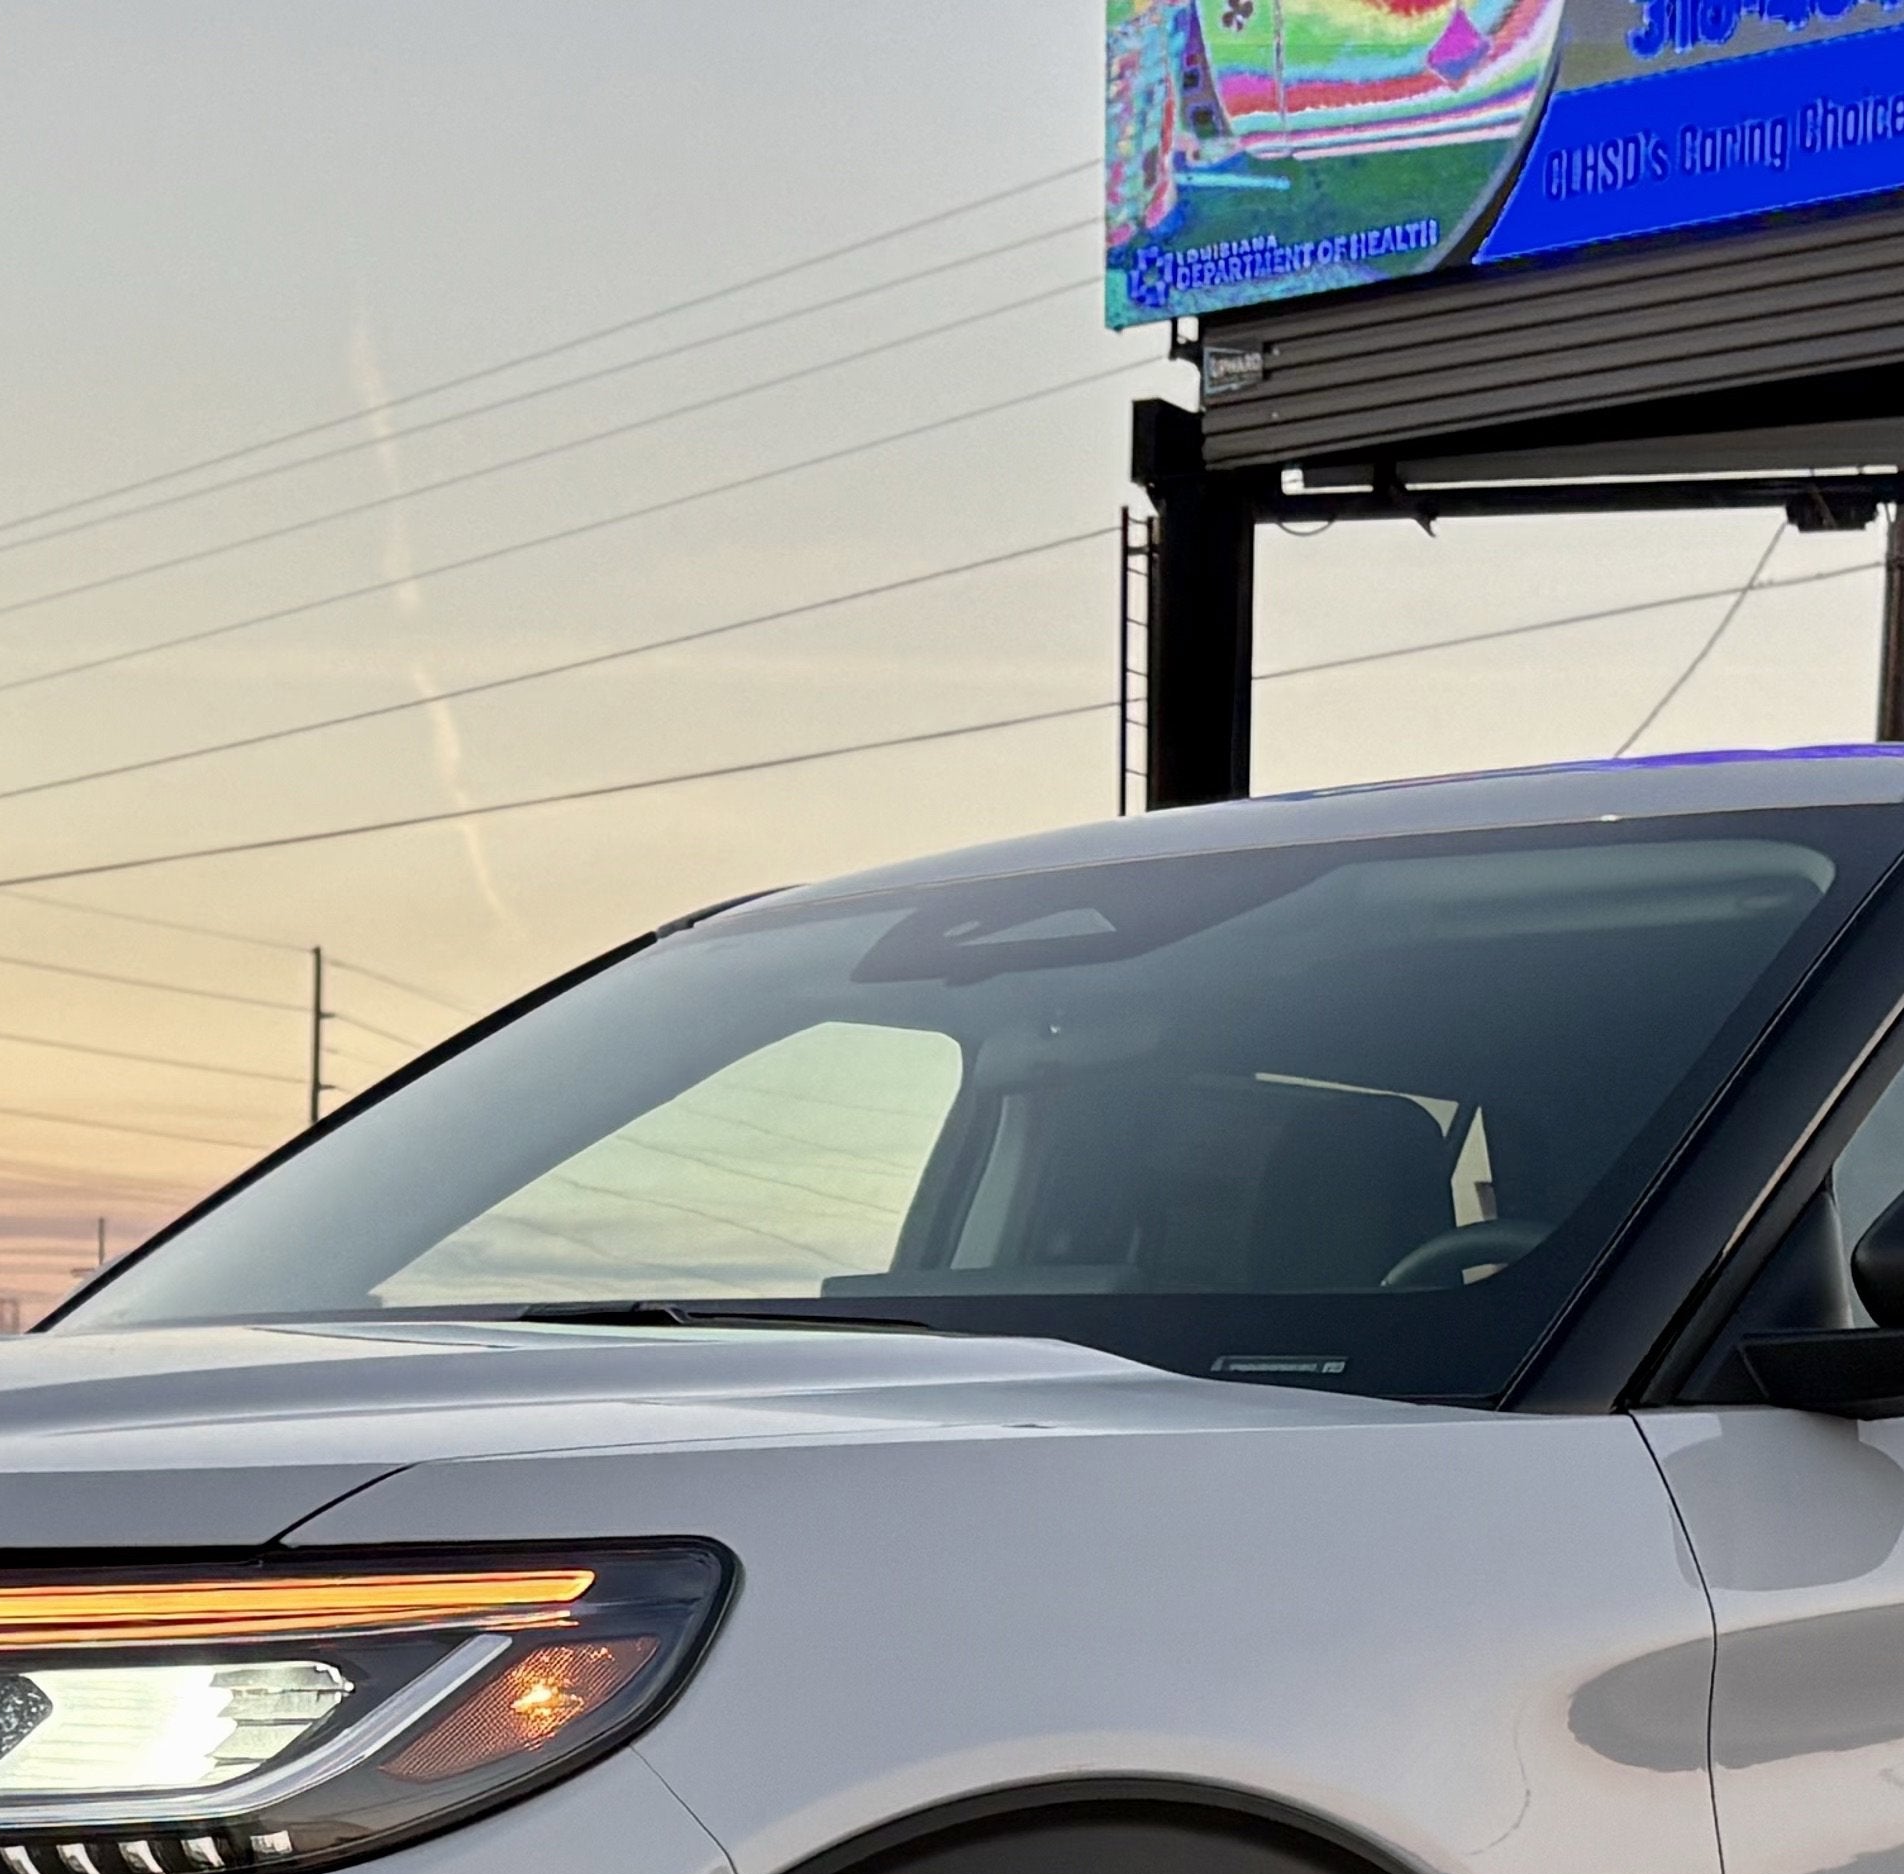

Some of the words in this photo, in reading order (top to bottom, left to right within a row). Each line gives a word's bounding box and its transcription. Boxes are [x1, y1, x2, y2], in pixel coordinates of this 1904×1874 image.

[1680, 118, 1790, 174] Caring
[1176, 242, 1313, 290] DEPARTMENT
[1317, 235, 1347, 264] OF
[1350, 219, 1437, 261] HEALTH
